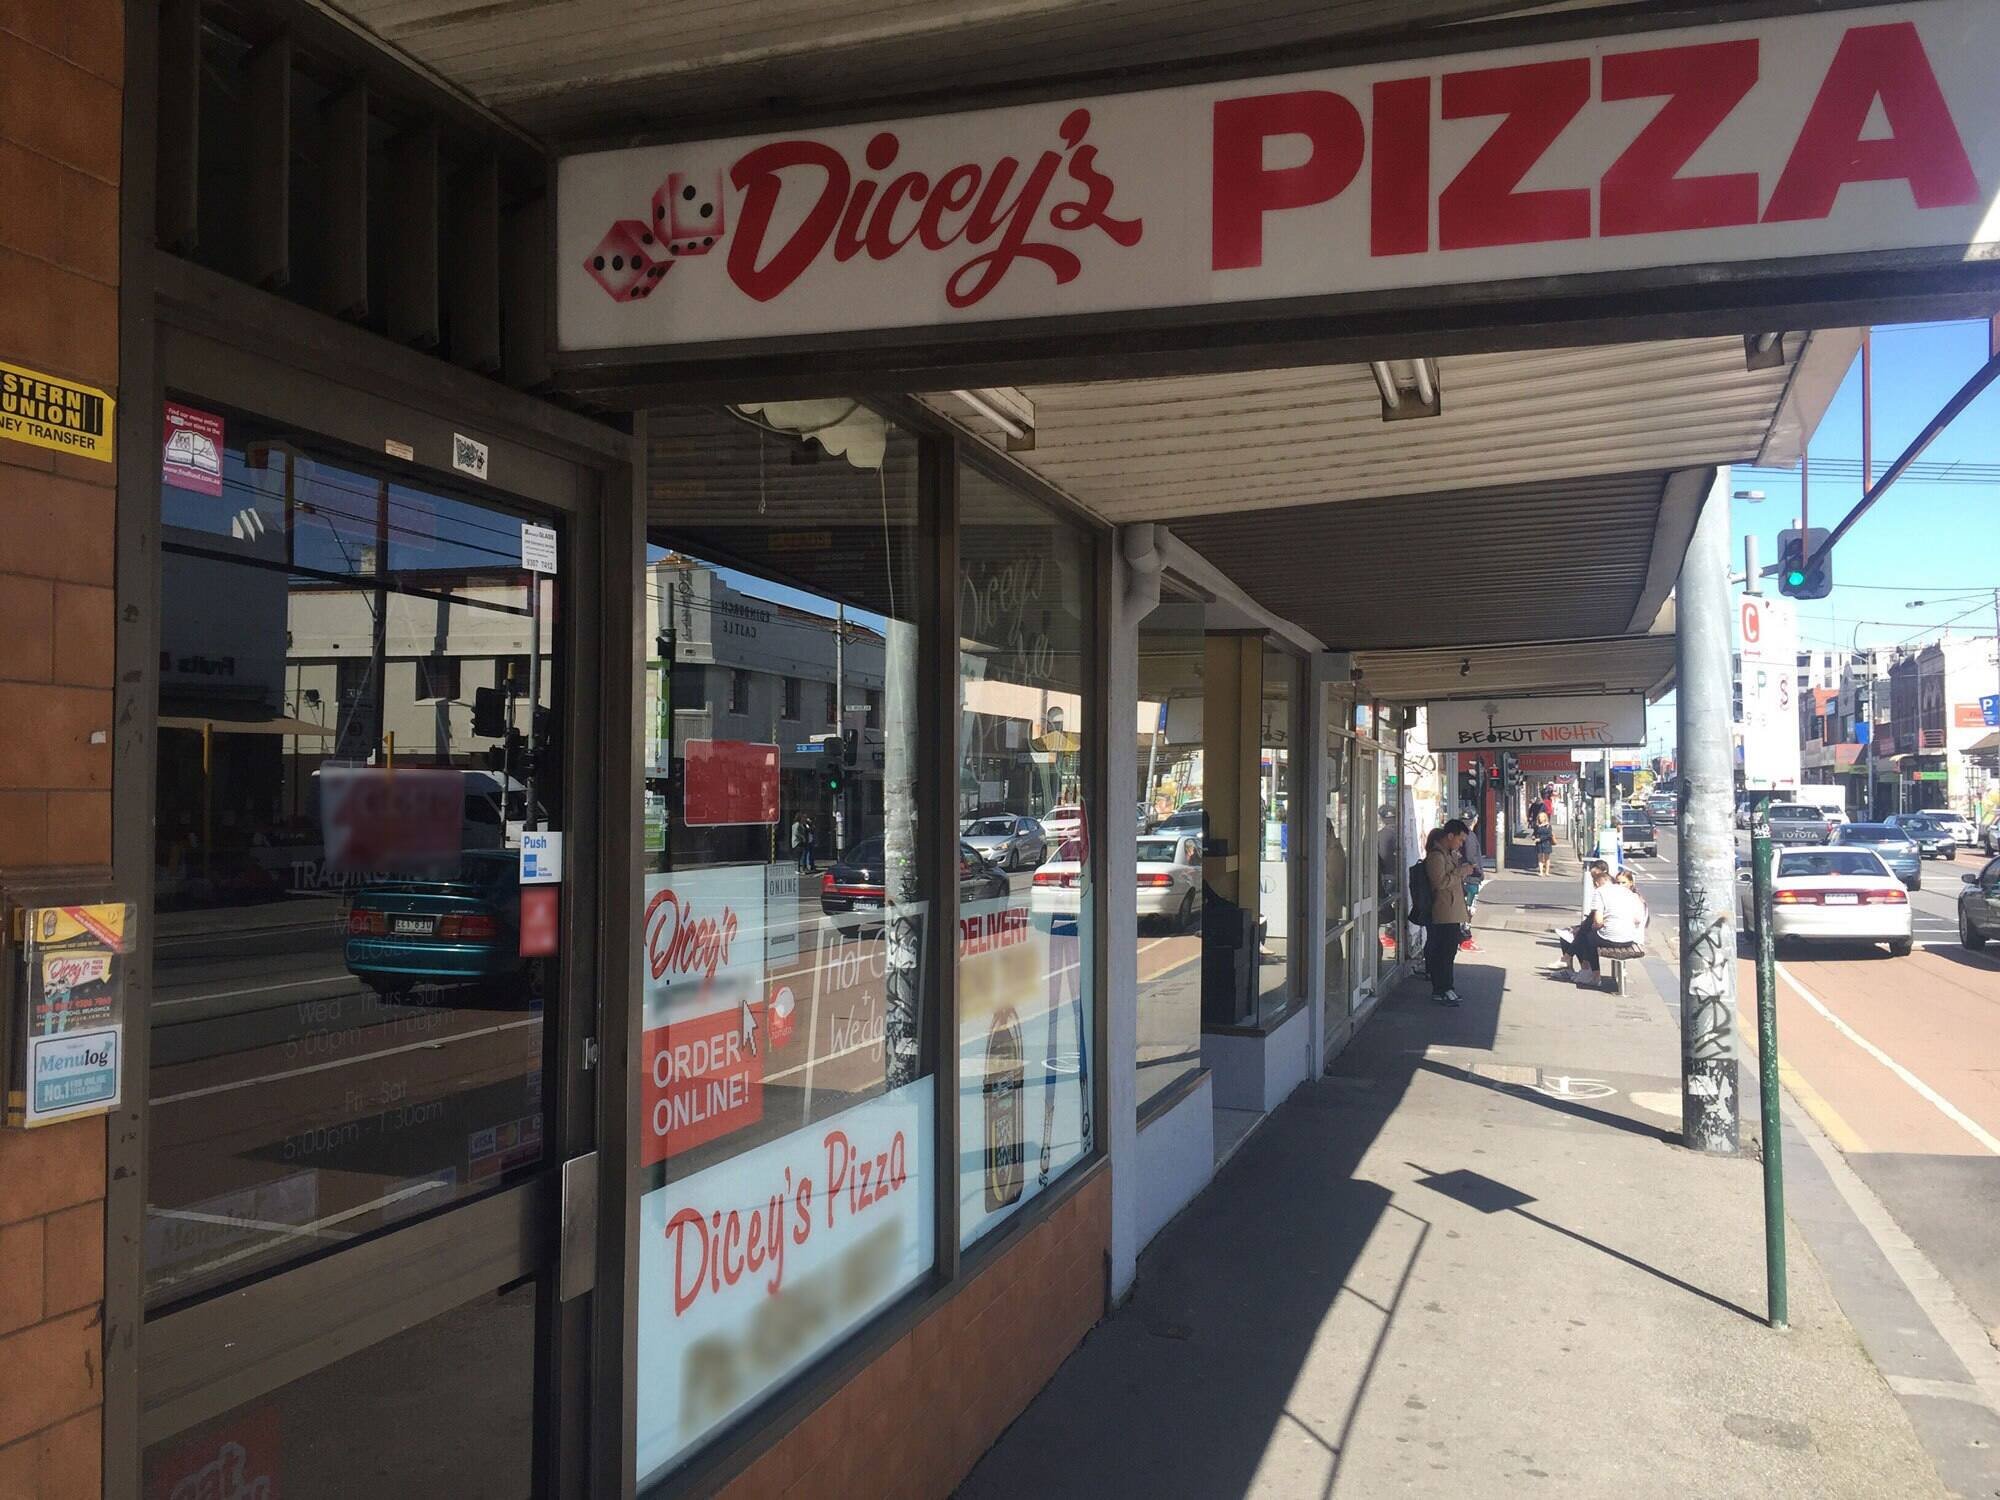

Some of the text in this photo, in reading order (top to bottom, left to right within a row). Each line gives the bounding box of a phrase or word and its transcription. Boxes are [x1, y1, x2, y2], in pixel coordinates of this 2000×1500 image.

[727, 21, 1982, 308] Dicey's PIZZA
[2, 392, 81, 429] UNION
[27, 422, 96, 450] TRANSFER
[523, 835, 547, 849] Push
[769, 877, 797, 896] ONLINE
[643, 888, 738, 980] Dicey's
[298, 999, 342, 1025] Wed
[831, 998, 884, 1063] Wedg
[38, 1048, 109, 1073] Menulog
[653, 1030, 741, 1089] ORDER
[653, 1071, 750, 1137] ONLINE!
[664, 1166, 813, 1318] Dicey's
[823, 1130, 907, 1229] Pizza
